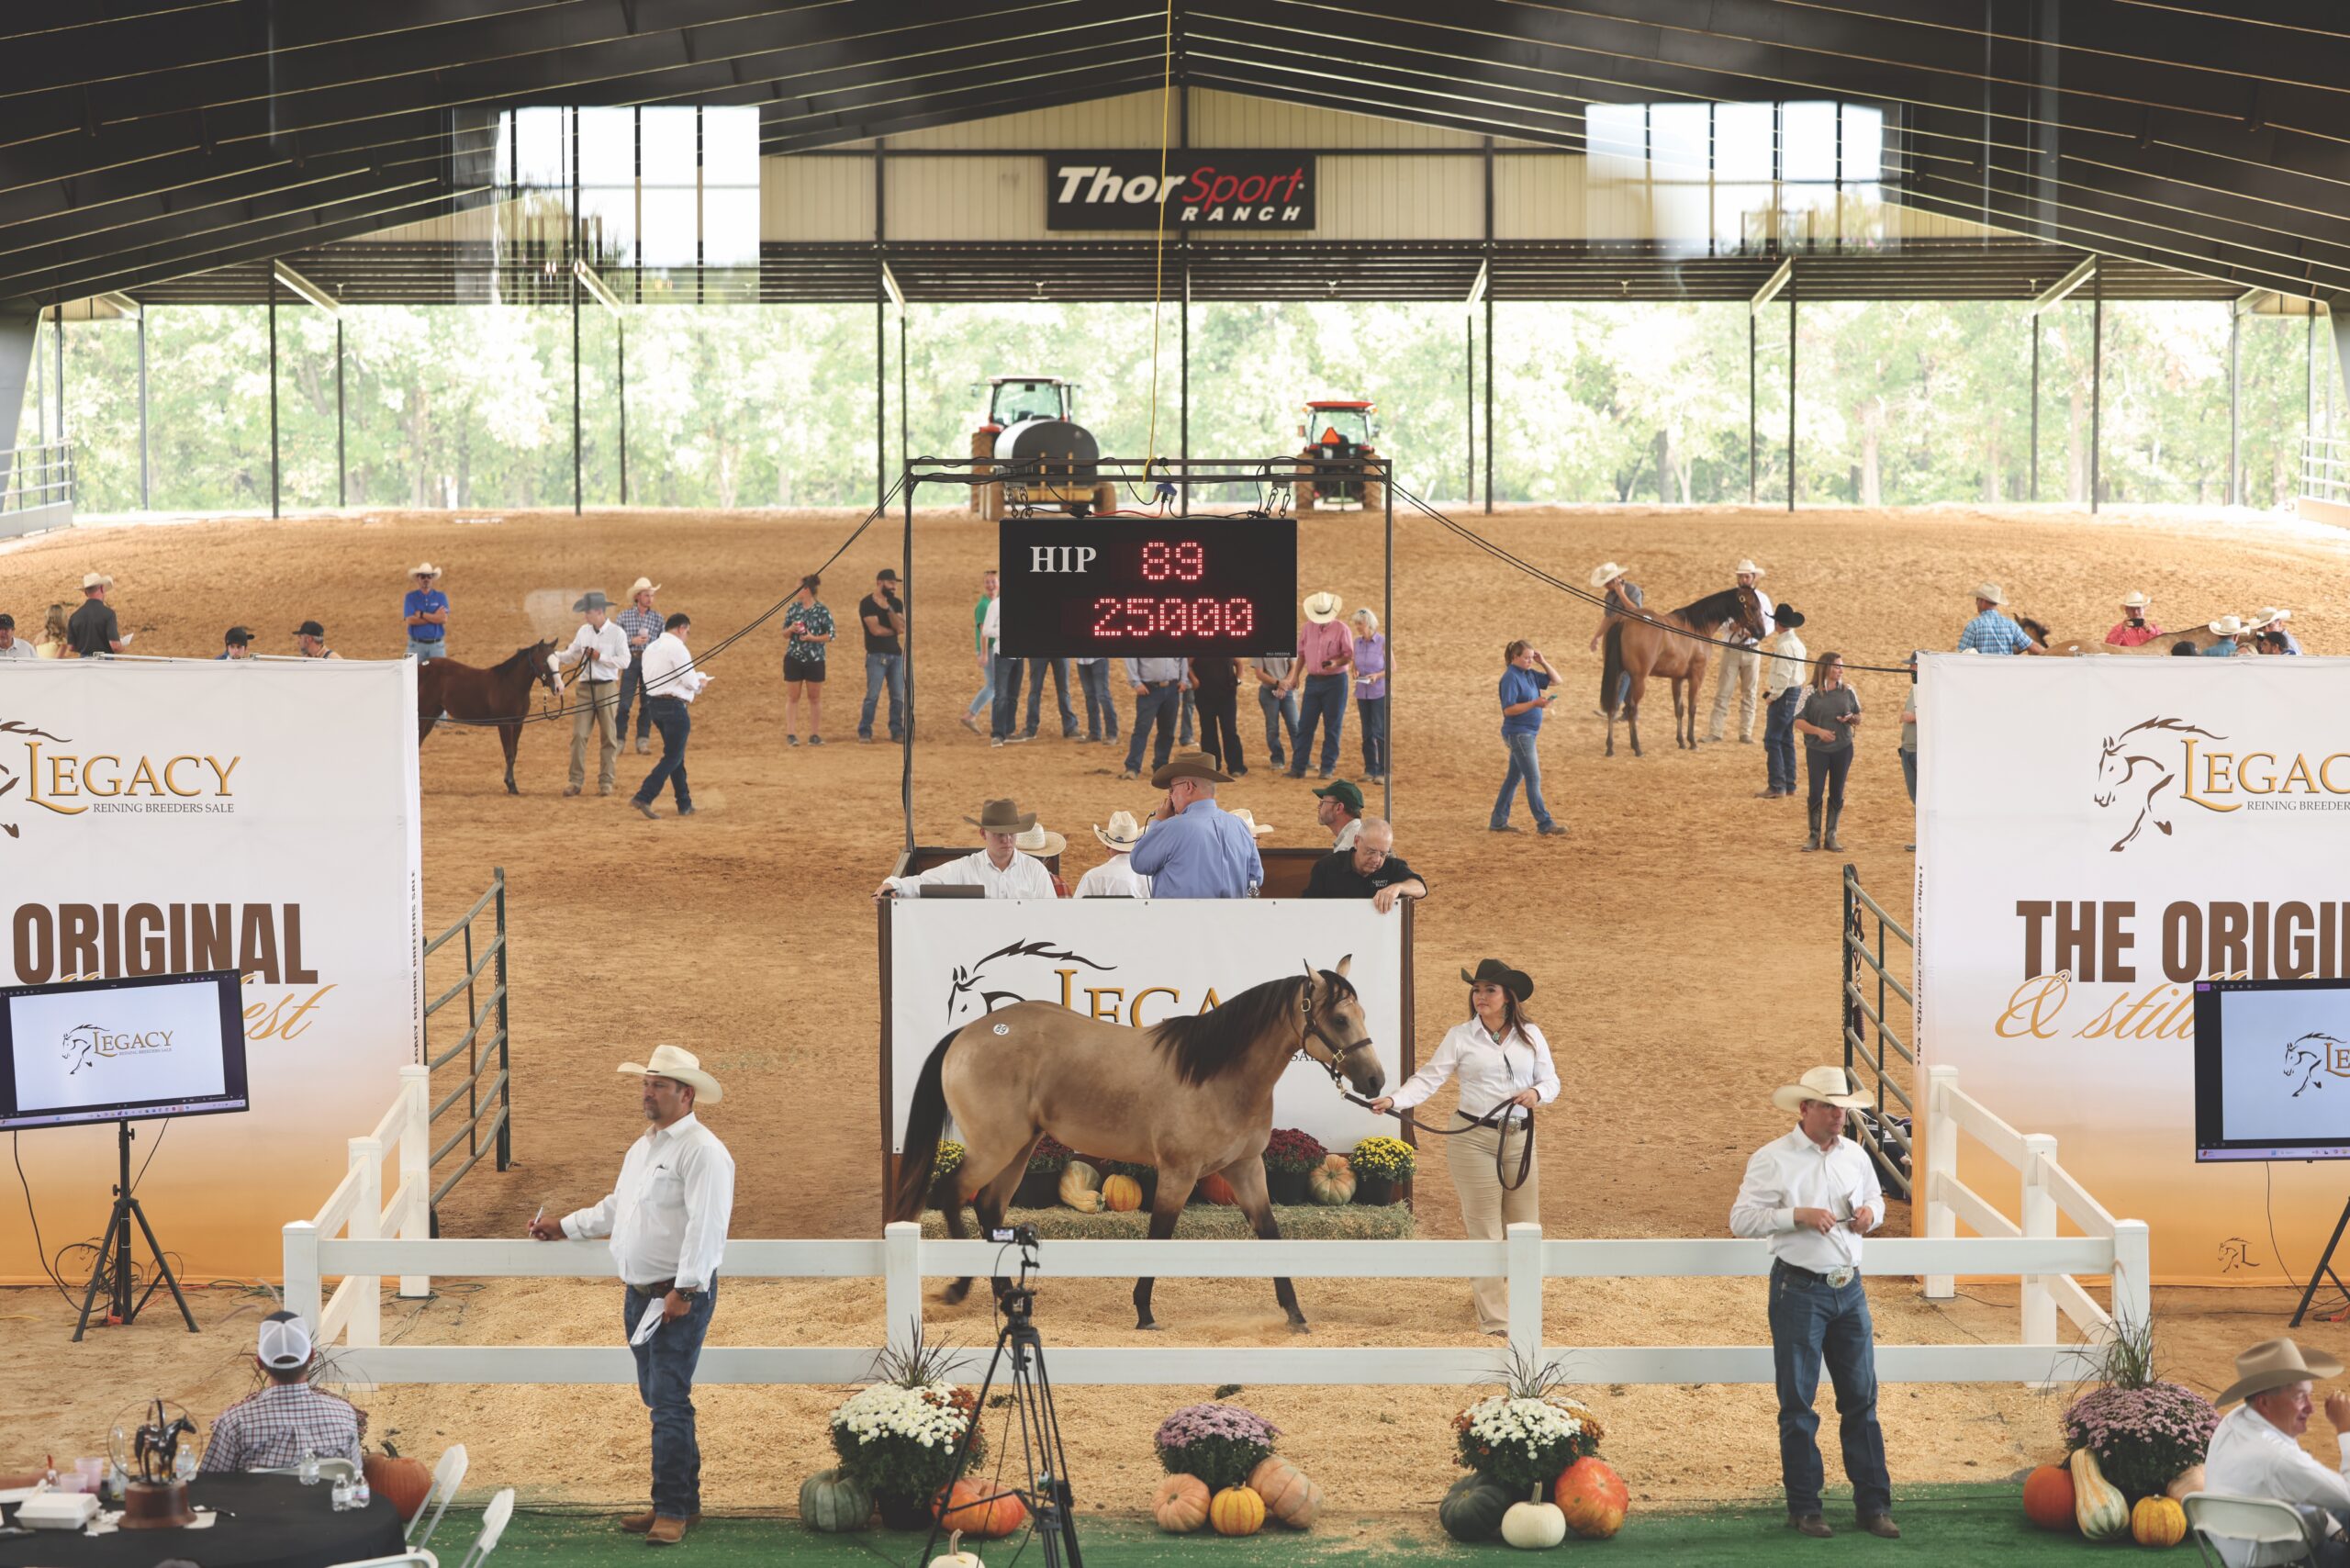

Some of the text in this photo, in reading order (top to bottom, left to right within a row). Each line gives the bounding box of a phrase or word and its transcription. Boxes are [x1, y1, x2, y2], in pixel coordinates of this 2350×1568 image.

[1181, 207, 1302, 221] RANCH
[1029, 546, 1098, 573] HIP
[1142, 541, 1203, 581] 89
[1094, 598, 1253, 637] 25000
[24, 741, 241, 815] LEGACY
[2179, 738, 2350, 812] LEGAC
[93, 803, 234, 813] REINING BREEDERS SALE
[2247, 801, 2350, 811] REINING BREEDER
[13, 902, 319, 985] ORIGINAL
[2016, 900, 2350, 984] THE ORIGI
[241, 982, 338, 1040] est
[1054, 969, 1223, 1029] EGA
[1995, 969, 2071, 1039] &
[93, 1030, 173, 1058] LEGACY
[995, 1024, 1007, 1035] 89
[1291, 1050, 1316, 1062] SA
